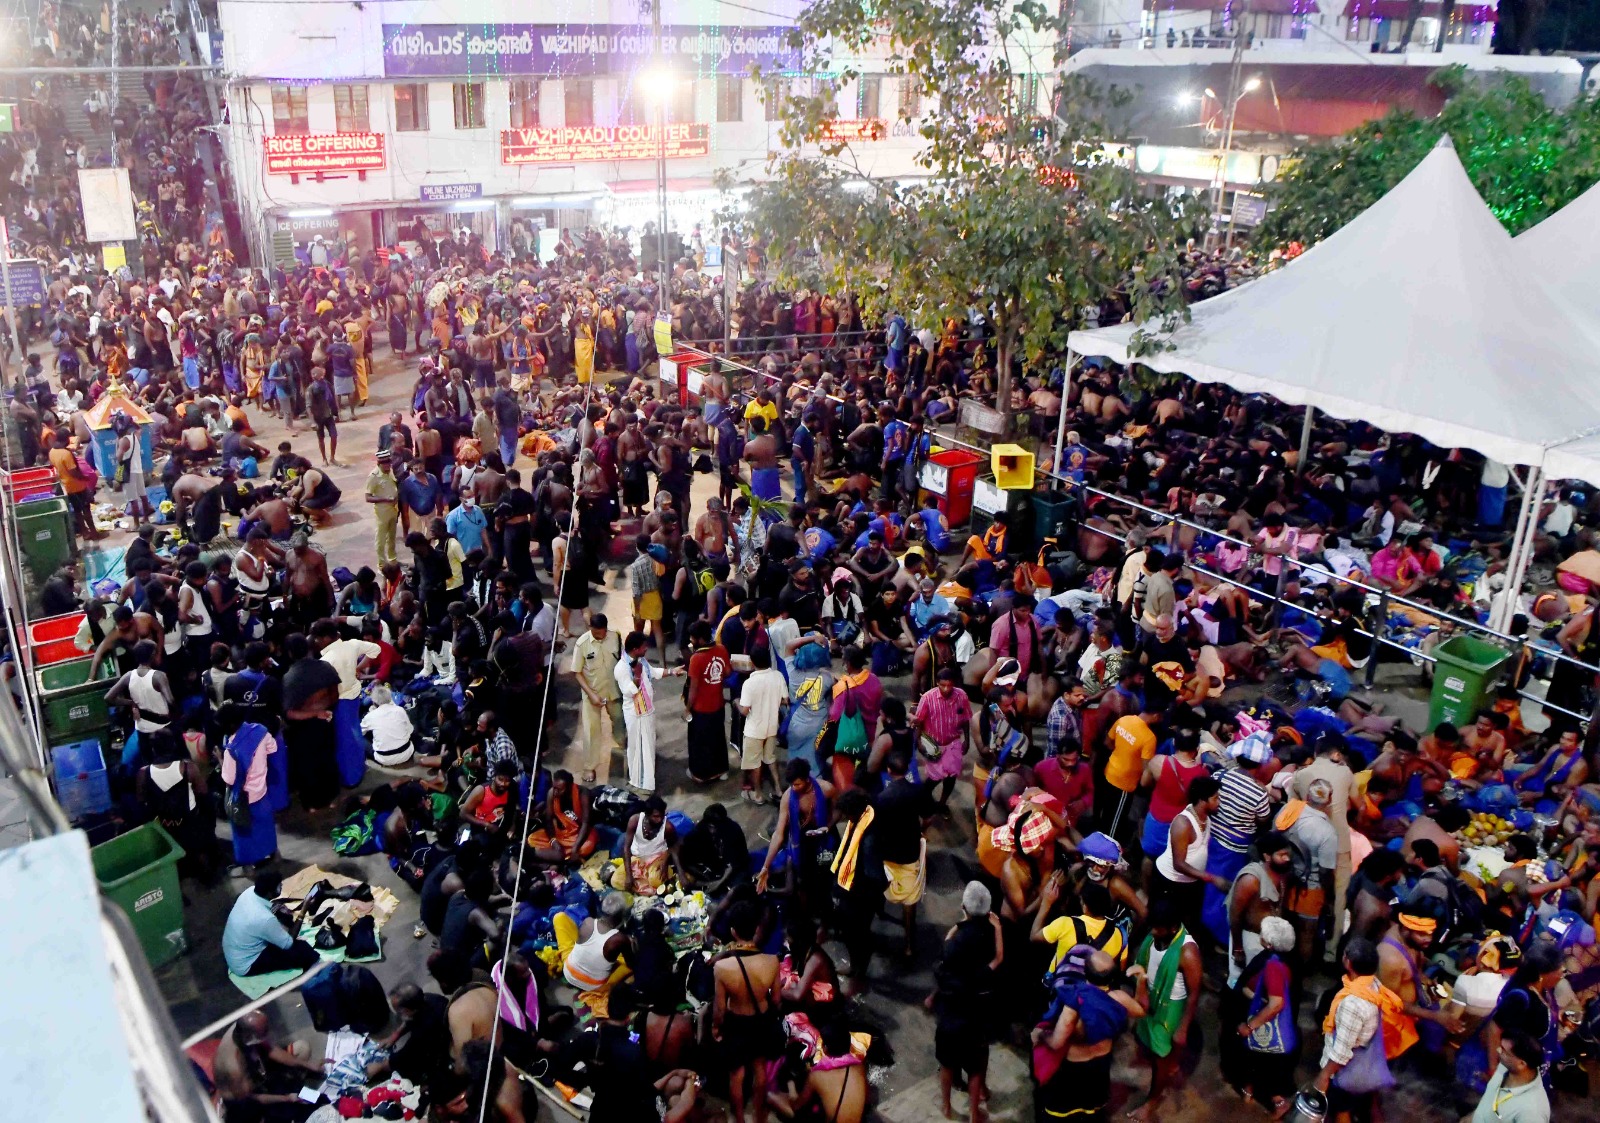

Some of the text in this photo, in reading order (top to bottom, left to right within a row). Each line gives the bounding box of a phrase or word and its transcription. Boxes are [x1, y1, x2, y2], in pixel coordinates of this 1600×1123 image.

[392, 31, 465, 55] വഴിപാട്
[541, 35, 617, 55] VAZHIPADU
[520, 126, 615, 145] VAZHIPAADU
[892, 124, 916, 137] LEGAL
[268, 135, 377, 152] RICE OFFERING
[428, 192, 471, 200] COUNTER
[445, 184, 477, 194] VAZHIPADU
[1115, 725, 1137, 746] POLICE
[134, 889, 164, 909] ARISTO
